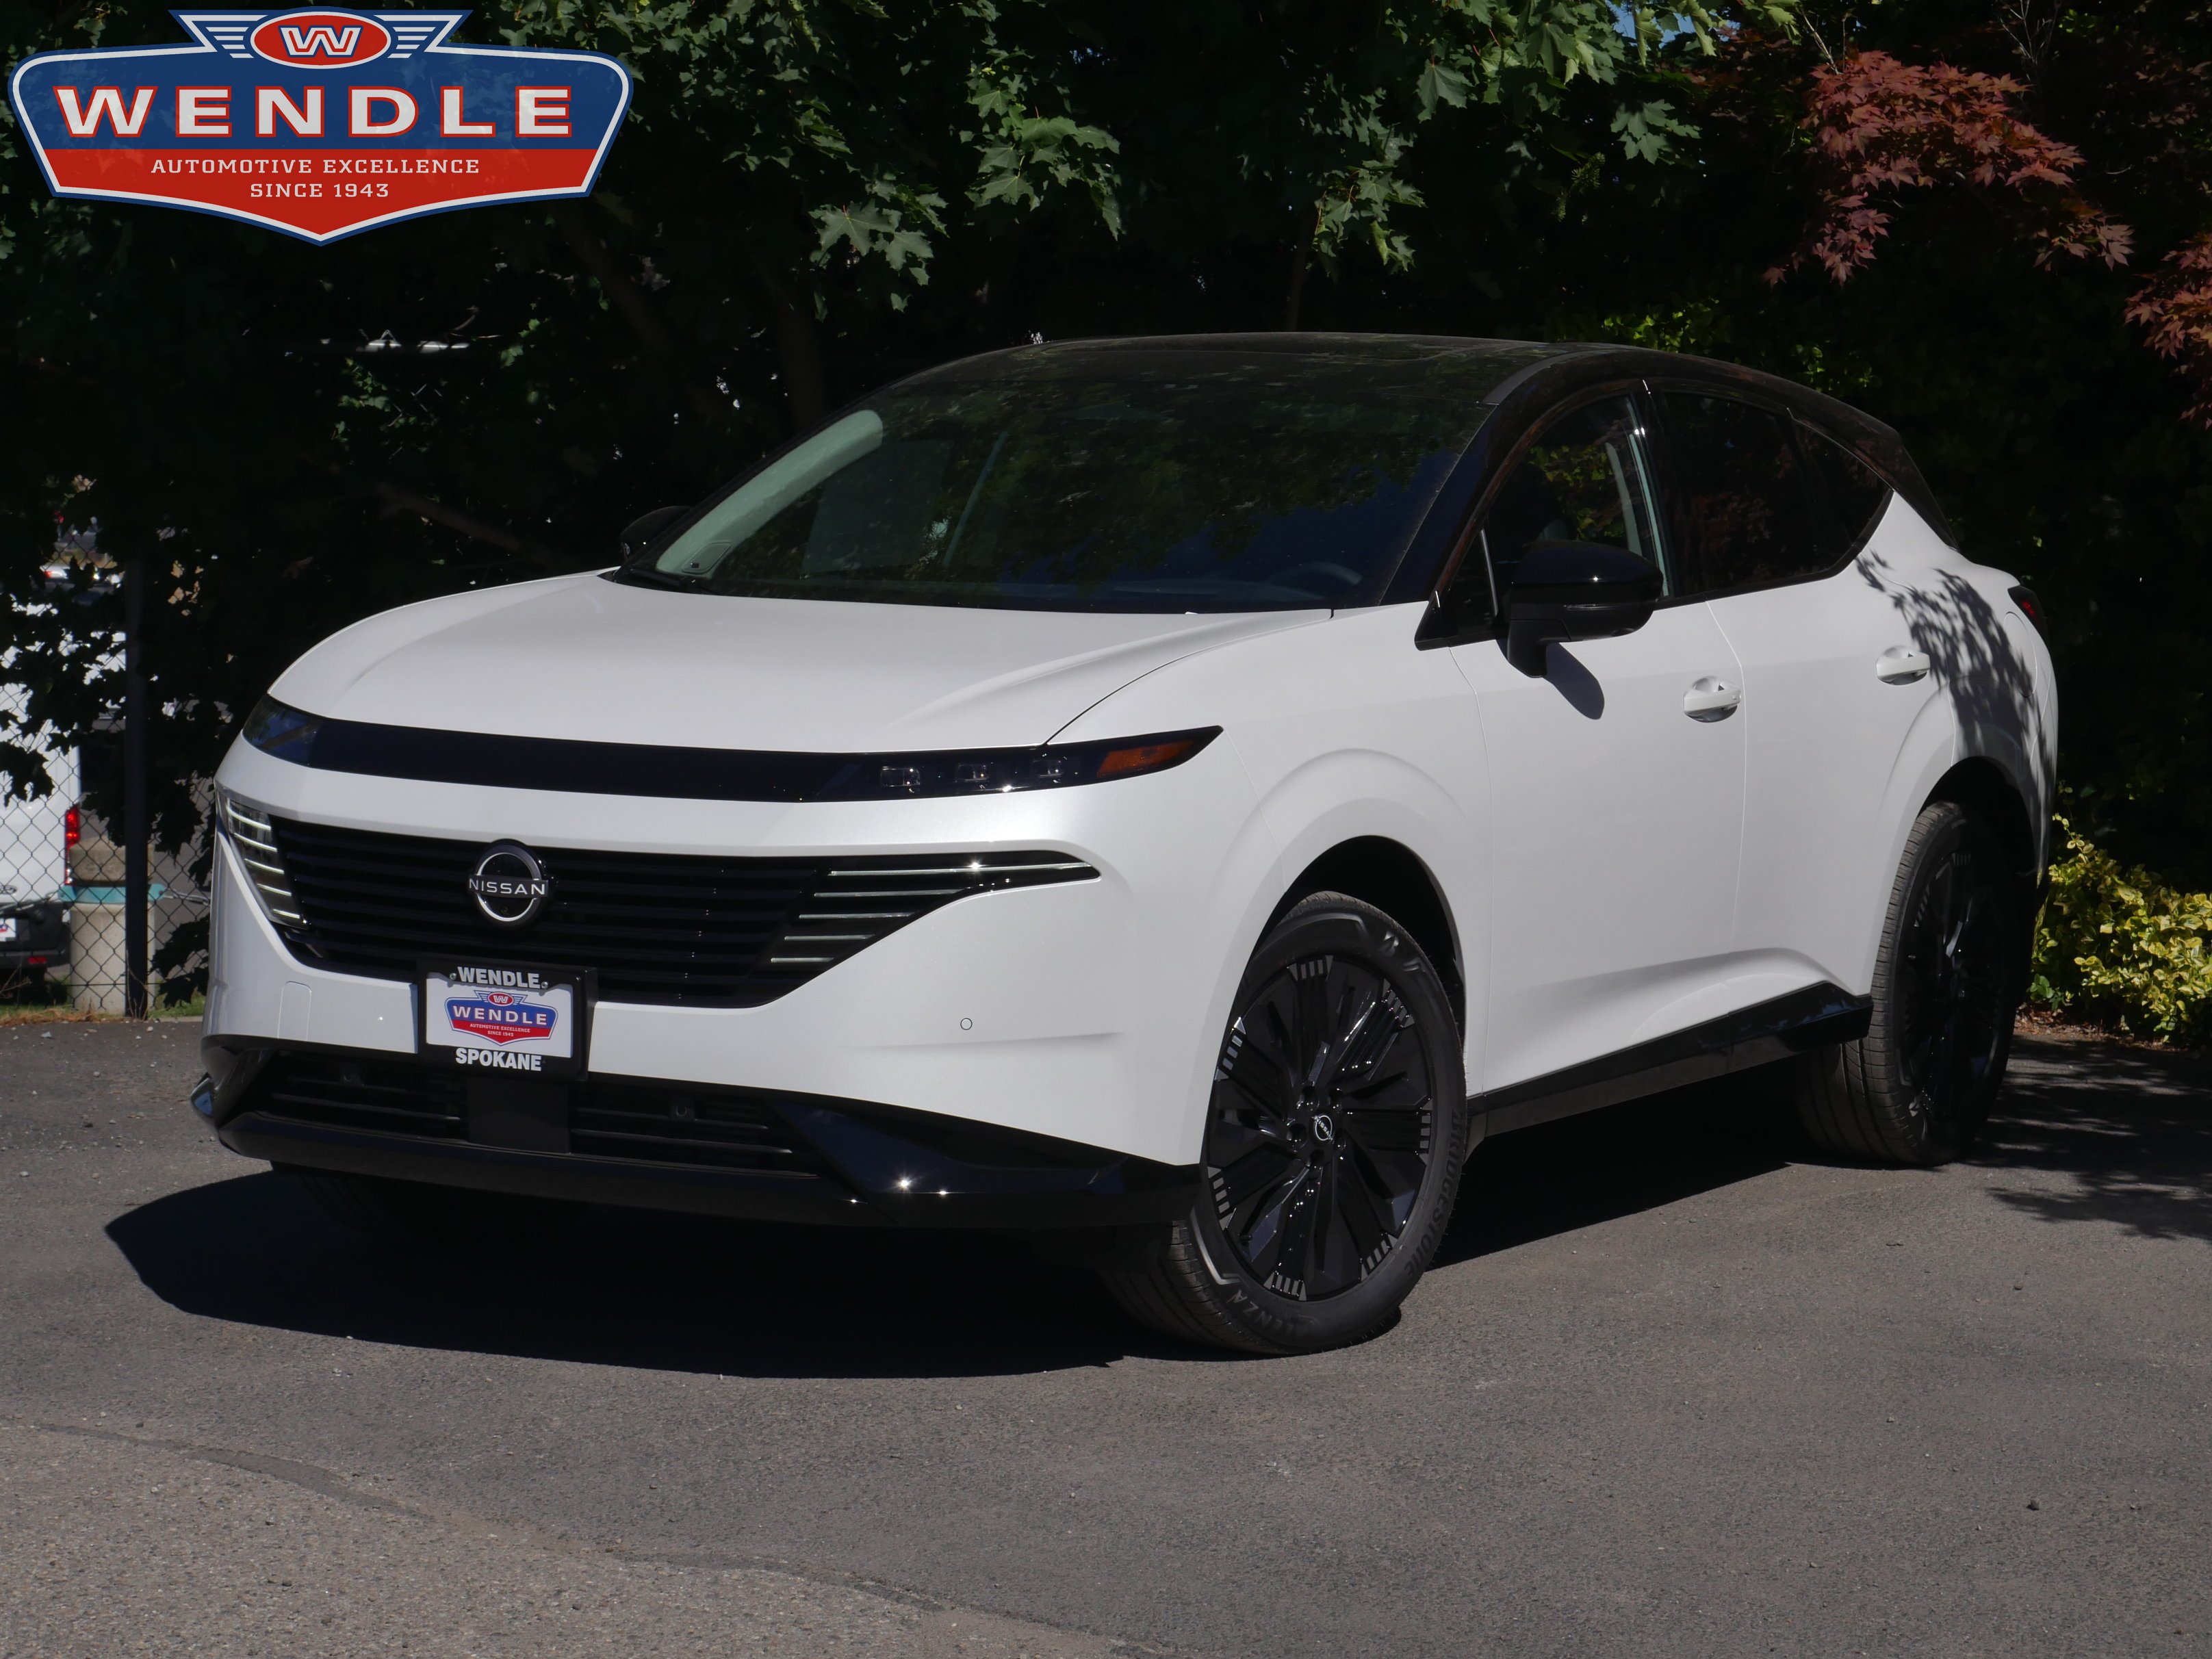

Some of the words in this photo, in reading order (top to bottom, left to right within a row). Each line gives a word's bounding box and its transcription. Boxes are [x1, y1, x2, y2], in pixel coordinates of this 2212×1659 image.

[468, 877, 546, 896] NISSAN
[457, 966, 541, 989] WENDLE
[452, 1005, 547, 1025] WENDLE
[455, 1047, 541, 1071] SPOKANE
